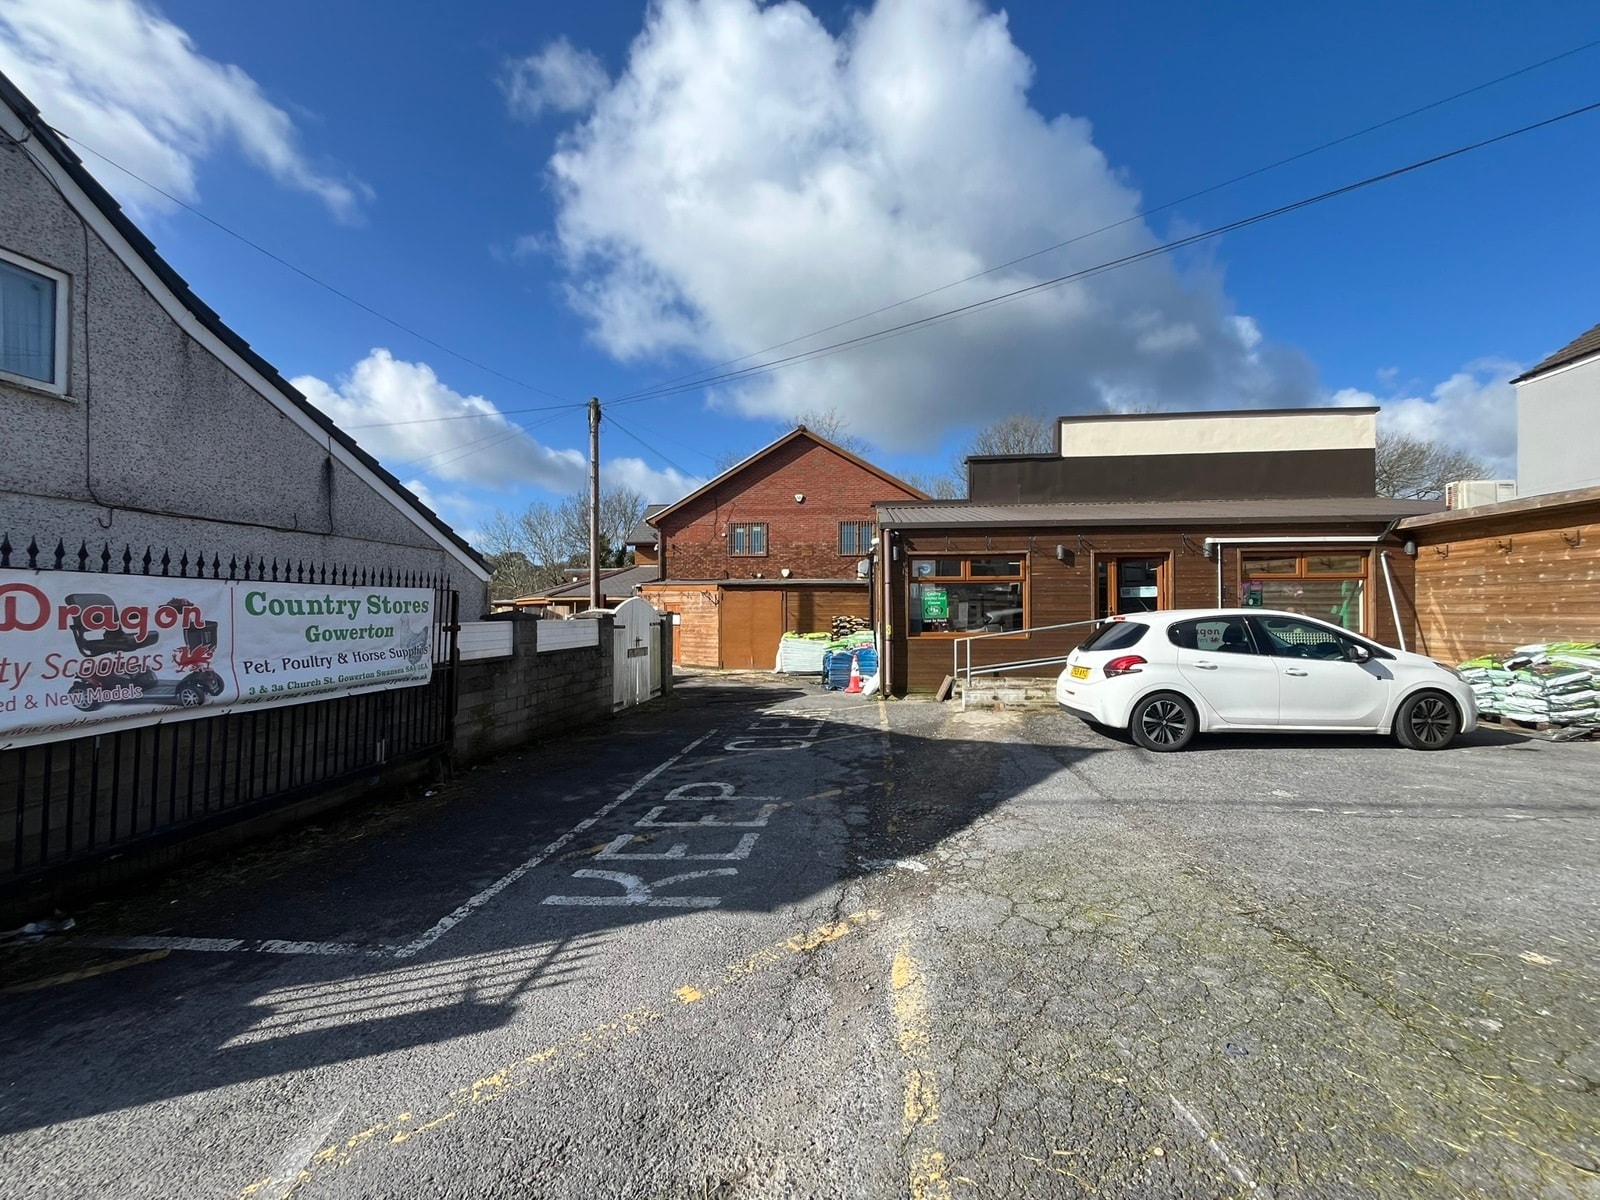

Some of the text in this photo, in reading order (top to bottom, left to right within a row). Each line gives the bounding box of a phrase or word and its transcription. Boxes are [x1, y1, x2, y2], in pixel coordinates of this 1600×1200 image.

[245, 591, 429, 621] Country Stores
[305, 624, 394, 643] Gowerton
[41, 651, 163, 680] Scooters
[243, 645, 428, 675] Pet, Poultry & Horse Supplies
[24, 694, 38, 710] &
[45, 691, 83, 707] New
[87, 684, 143, 703] Models
[249, 687, 256, 695] 3
[259, 685, 269, 694] &
[271, 684, 284, 692] 3a
[287, 676, 321, 690] Church
[338, 672, 375, 683] Gowerton
[541, 782, 781, 908] KEEP
